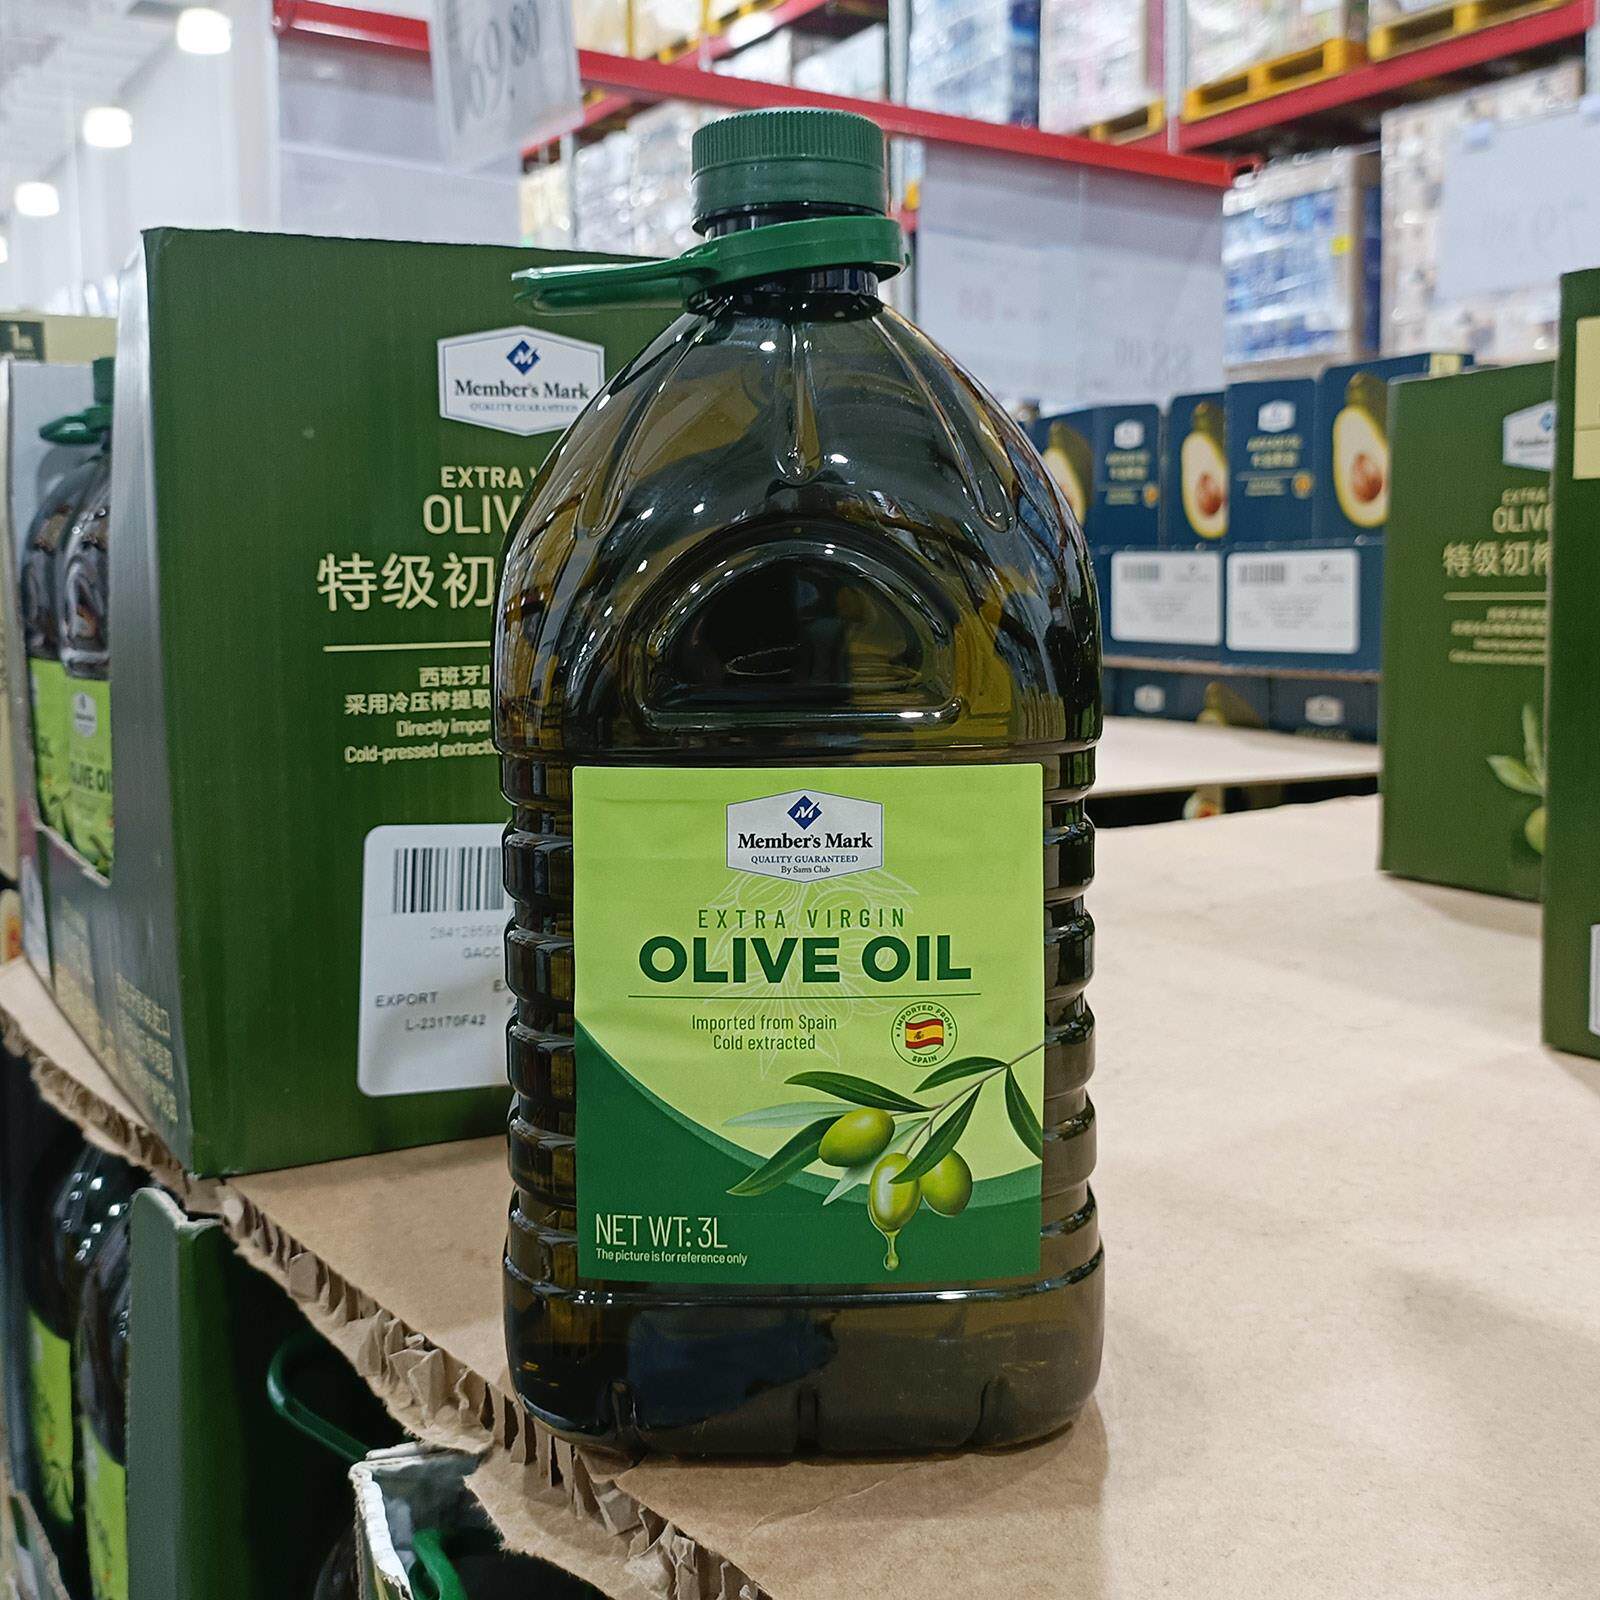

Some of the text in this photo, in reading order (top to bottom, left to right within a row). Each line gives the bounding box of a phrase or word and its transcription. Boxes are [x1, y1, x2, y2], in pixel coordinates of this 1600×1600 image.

[454, 378, 590, 400] Member's Mark
[440, 466, 524, 489] EXTRA
[396, 719, 449, 738] Directly
[344, 742, 439, 764] Cold-pressed
[737, 832, 873, 849] Member's Mark
[751, 855, 859, 865] QUALITY GUARANTEED
[781, 865, 791, 875] By
[813, 865, 831, 873] Club
[698, 908, 905, 929] EXTRA VIRGIN
[639, 934, 972, 984] OLIVE OIL
[375, 990, 438, 1008] EXPORT
[691, 1014, 837, 1032] Imported from Spain
[896, 1005, 953, 1031] IMPORTED FROM
[713, 1034, 816, 1051] Cold extracted
[911, 1055, 938, 1064] SPAIN
[595, 1213, 728, 1249] NET WT: 3L
[595, 1248, 748, 1266] The picture is for reference only
